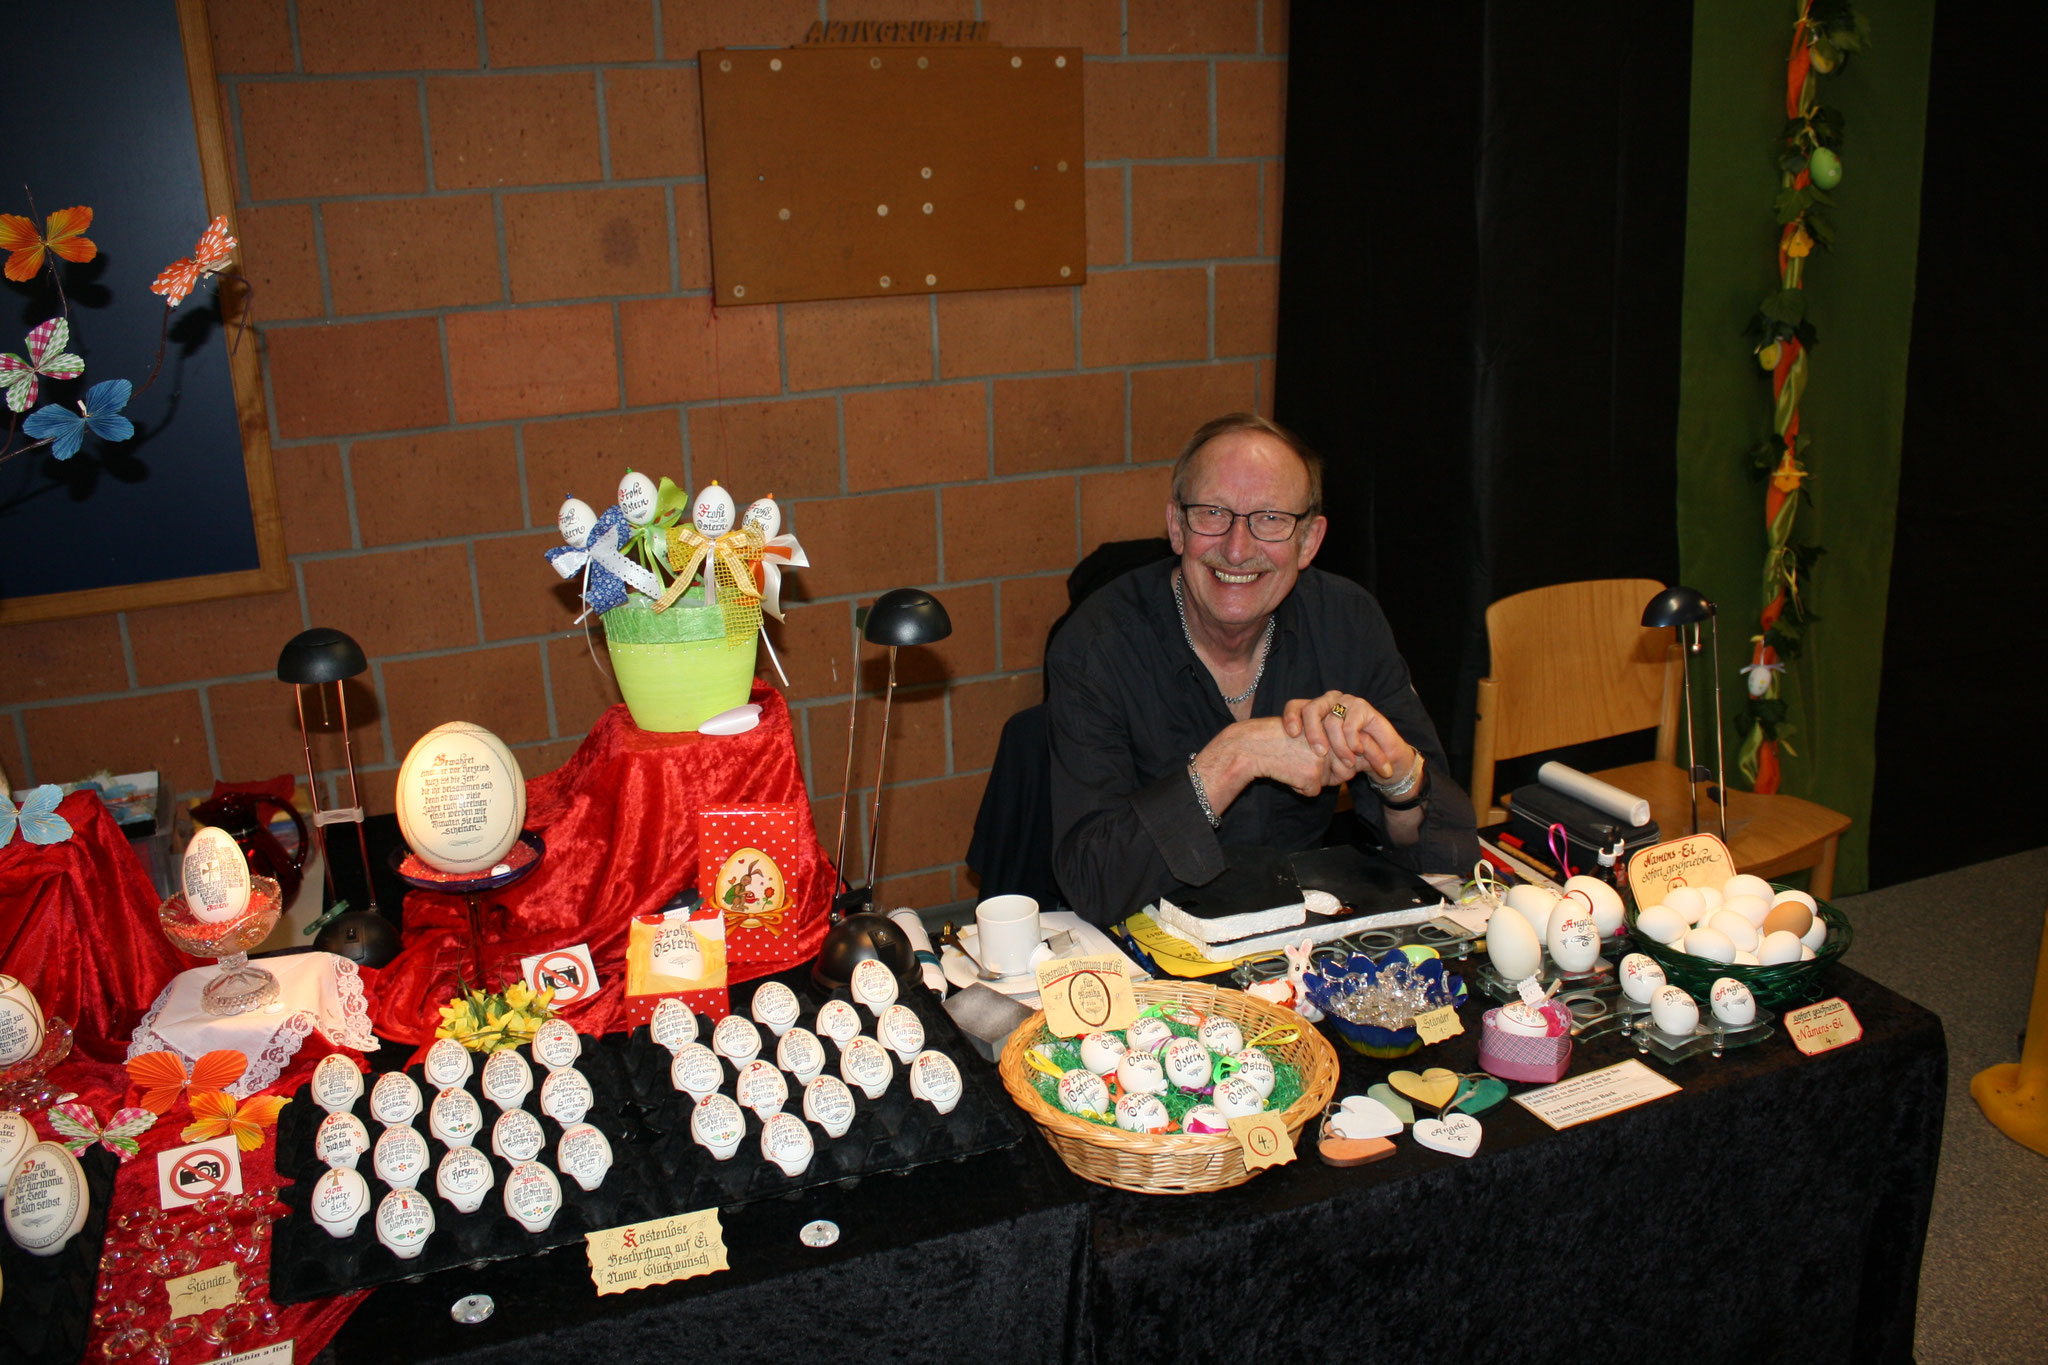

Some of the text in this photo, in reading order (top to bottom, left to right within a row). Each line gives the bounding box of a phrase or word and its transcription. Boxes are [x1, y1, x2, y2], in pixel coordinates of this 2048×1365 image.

[804, 20, 988, 43] AKTIVGRUPPEN
[619, 482, 643, 502] Frohe
[622, 498, 649, 515] Ostern
[698, 503, 726, 522] Frohe
[562, 525, 585, 539] stern
[697, 520, 728, 531] Ostern
[655, 924, 694, 944] Frohe
[653, 939, 699, 958] Ostern
[1205, 1021, 1237, 1037] Ostern
[1796, 1018, 1844, 1041] Namens-Ei
[1170, 1040, 1198, 1058] Frohe
[1175, 1053, 1205, 1071] Ostern
[1241, 1062, 1273, 1074] Ostern
[1067, 1076, 1100, 1102] Ostern
[1430, 1119, 1472, 1137] Angela
[21, 1160, 46, 1175] Das
[25, 1176, 64, 1192] Harmonie
[27, 1189, 48, 1201] Seele
[621, 1220, 688, 1250] Kostenlose
[607, 1231, 709, 1268] Beschriftung auf Ei
[643, 1252, 710, 1278] Glückwunsch
[178, 1275, 232, 1298] Ständer
